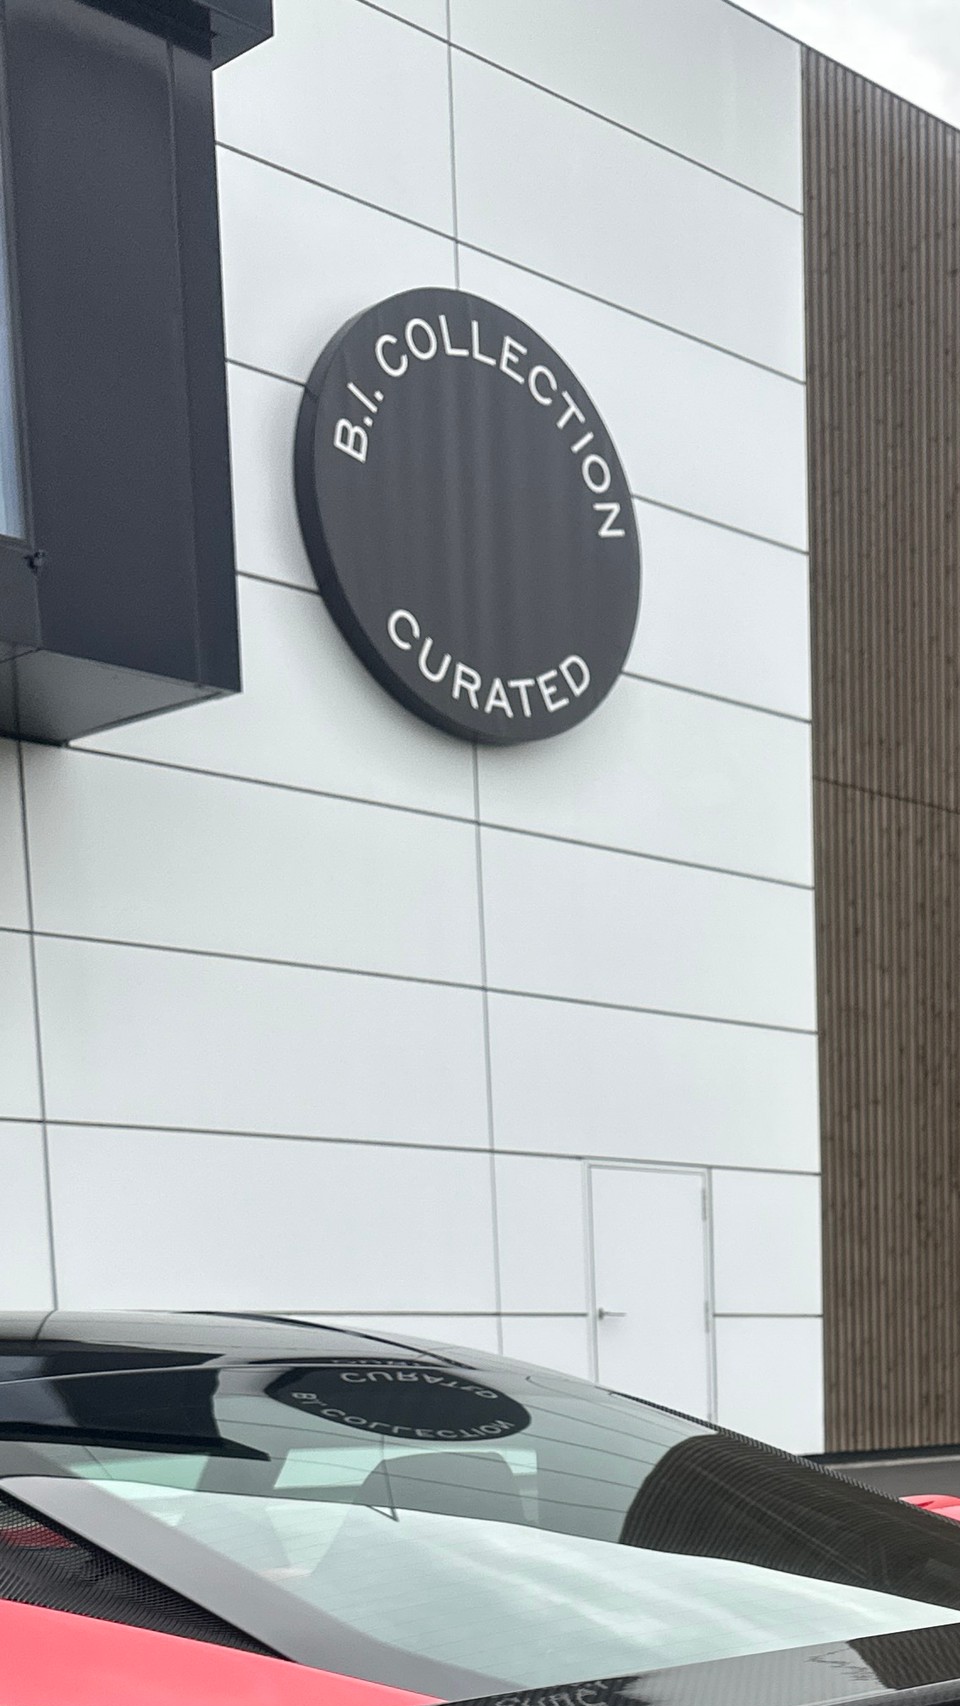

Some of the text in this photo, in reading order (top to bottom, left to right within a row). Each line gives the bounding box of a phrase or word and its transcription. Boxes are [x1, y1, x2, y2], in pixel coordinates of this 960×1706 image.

[333, 314, 627, 538] B.I. COLLECTION
[387, 609, 592, 719] CURATED
